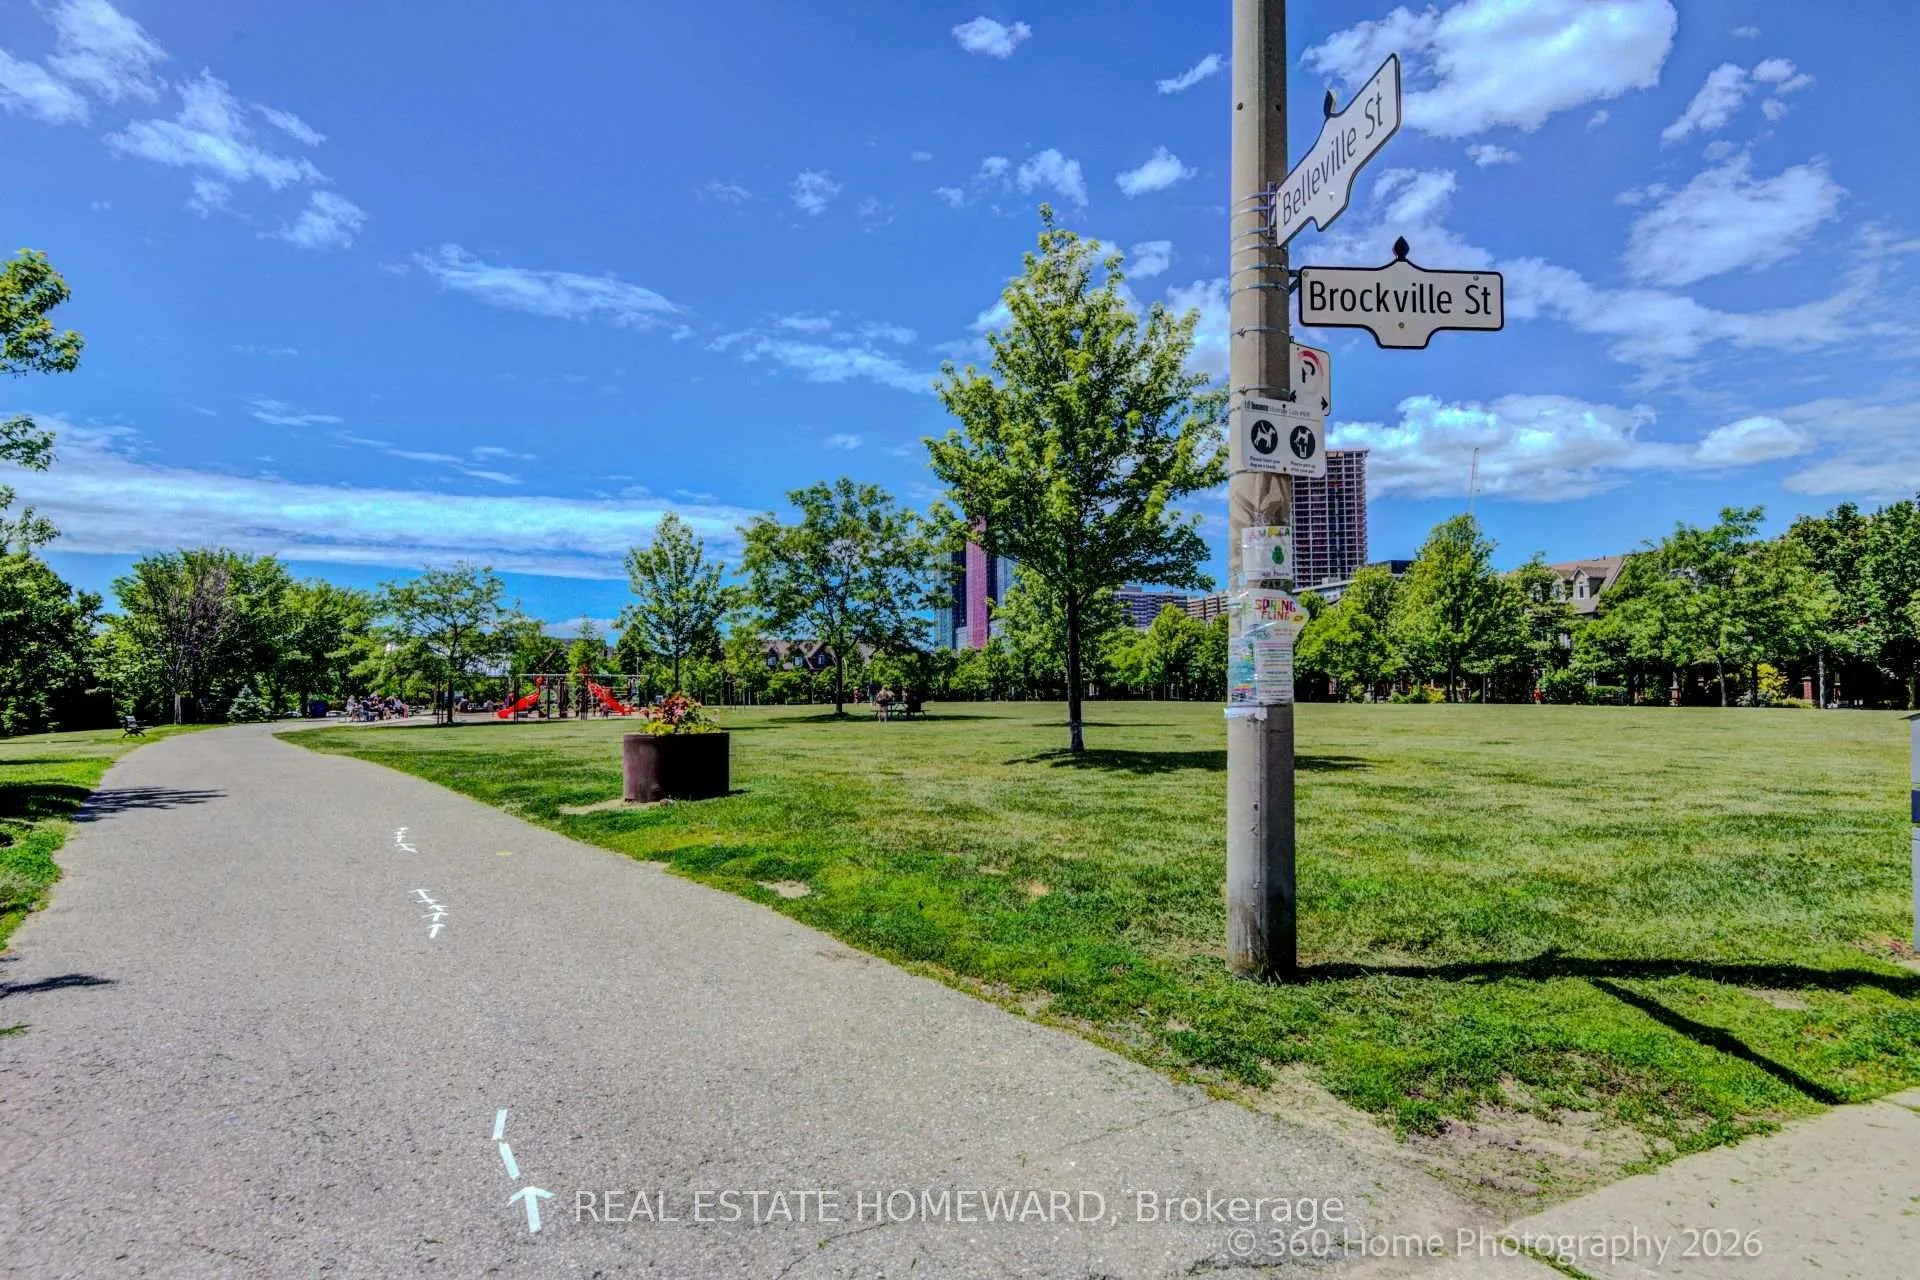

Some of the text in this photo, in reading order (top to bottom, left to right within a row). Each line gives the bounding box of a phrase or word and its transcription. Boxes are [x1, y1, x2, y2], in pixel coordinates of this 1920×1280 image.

[1282, 91, 1384, 225] Belleville St
[1309, 280, 1492, 315] Brockville St
